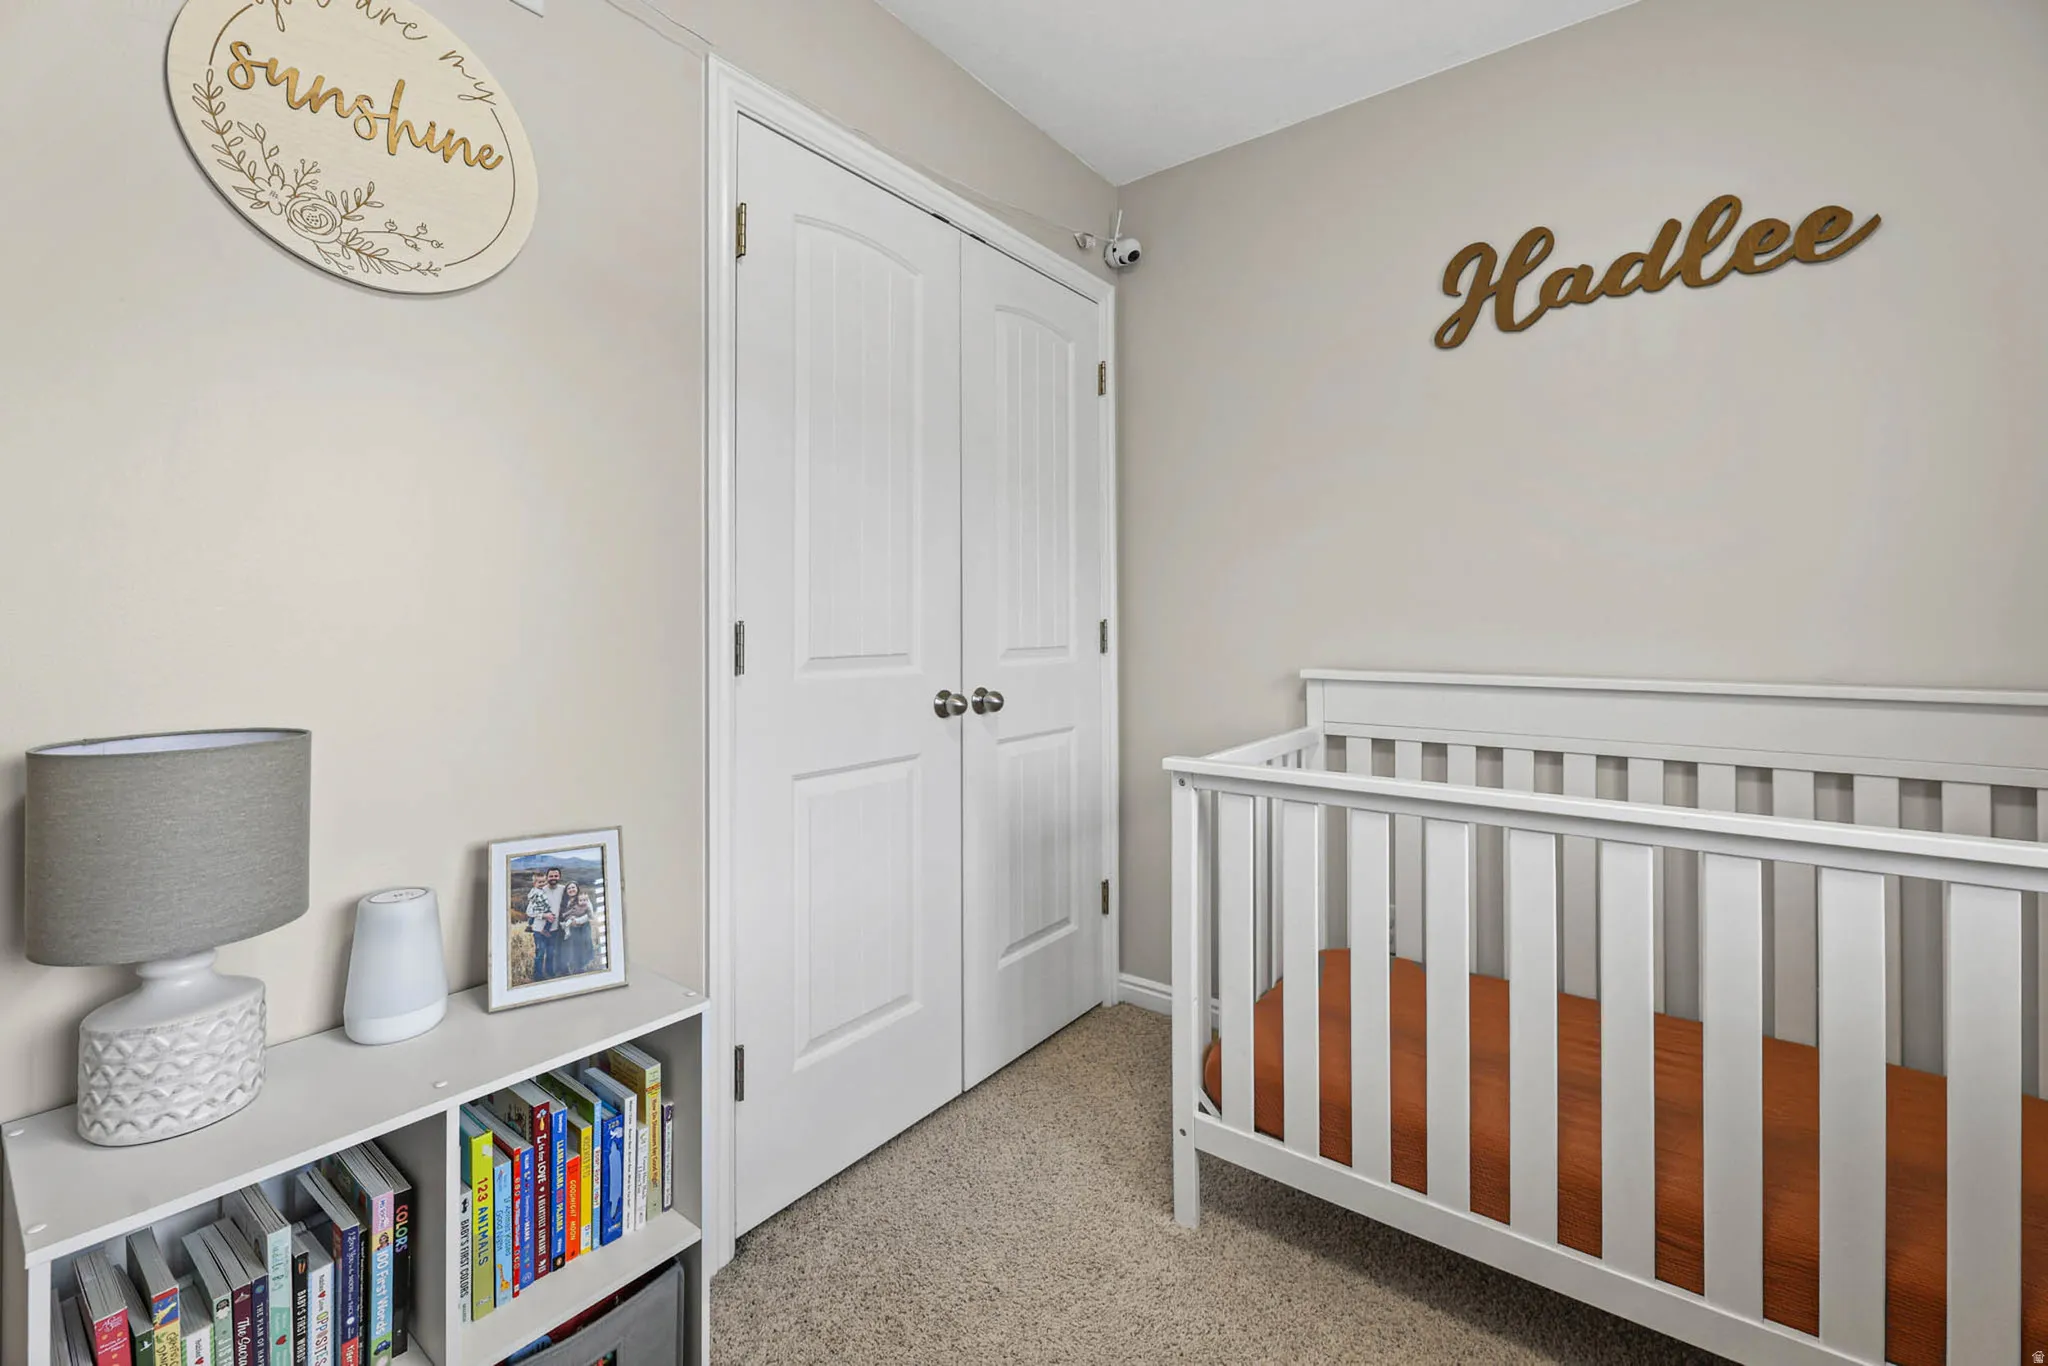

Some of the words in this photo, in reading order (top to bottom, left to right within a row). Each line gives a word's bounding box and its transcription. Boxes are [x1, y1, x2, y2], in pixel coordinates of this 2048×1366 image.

[438, 50, 497, 105] my
[227, 40, 504, 170] sunshine
[1434, 194, 1882, 349] Hadlee
[556, 1139, 564, 1165] LLAMA
[537, 1161, 547, 1184] LOVE
[556, 1164, 564, 1190] LLAMA
[477, 1177, 489, 1203] 123
[569, 1179, 577, 1218] GOODNIGHT
[394, 1203, 409, 1254] COLORS
[556, 1202, 564, 1233] PAJAMA
[569, 1220, 577, 1241] MOON
[461, 1218, 470, 1247] BABY'S
[477, 1206, 489, 1267] ANIMALS
[376, 1250, 390, 1270] 100
[460, 1245, 469, 1269] FIRST
[375, 1269, 390, 1297] First
[460, 1266, 469, 1299] COLORS
[256, 1302, 264, 1318] THE
[297, 1289, 307, 1316] BABY'S
[375, 1295, 390, 1336] Words
[237, 1316, 251, 1338] The
[256, 1318, 265, 1338] PLAN
[297, 1314, 307, 1337] FIRST
[314, 1311, 329, 1366] OPPOSITES
[257, 1337, 265, 1348] OF
[297, 1337, 307, 1364] WORDS
